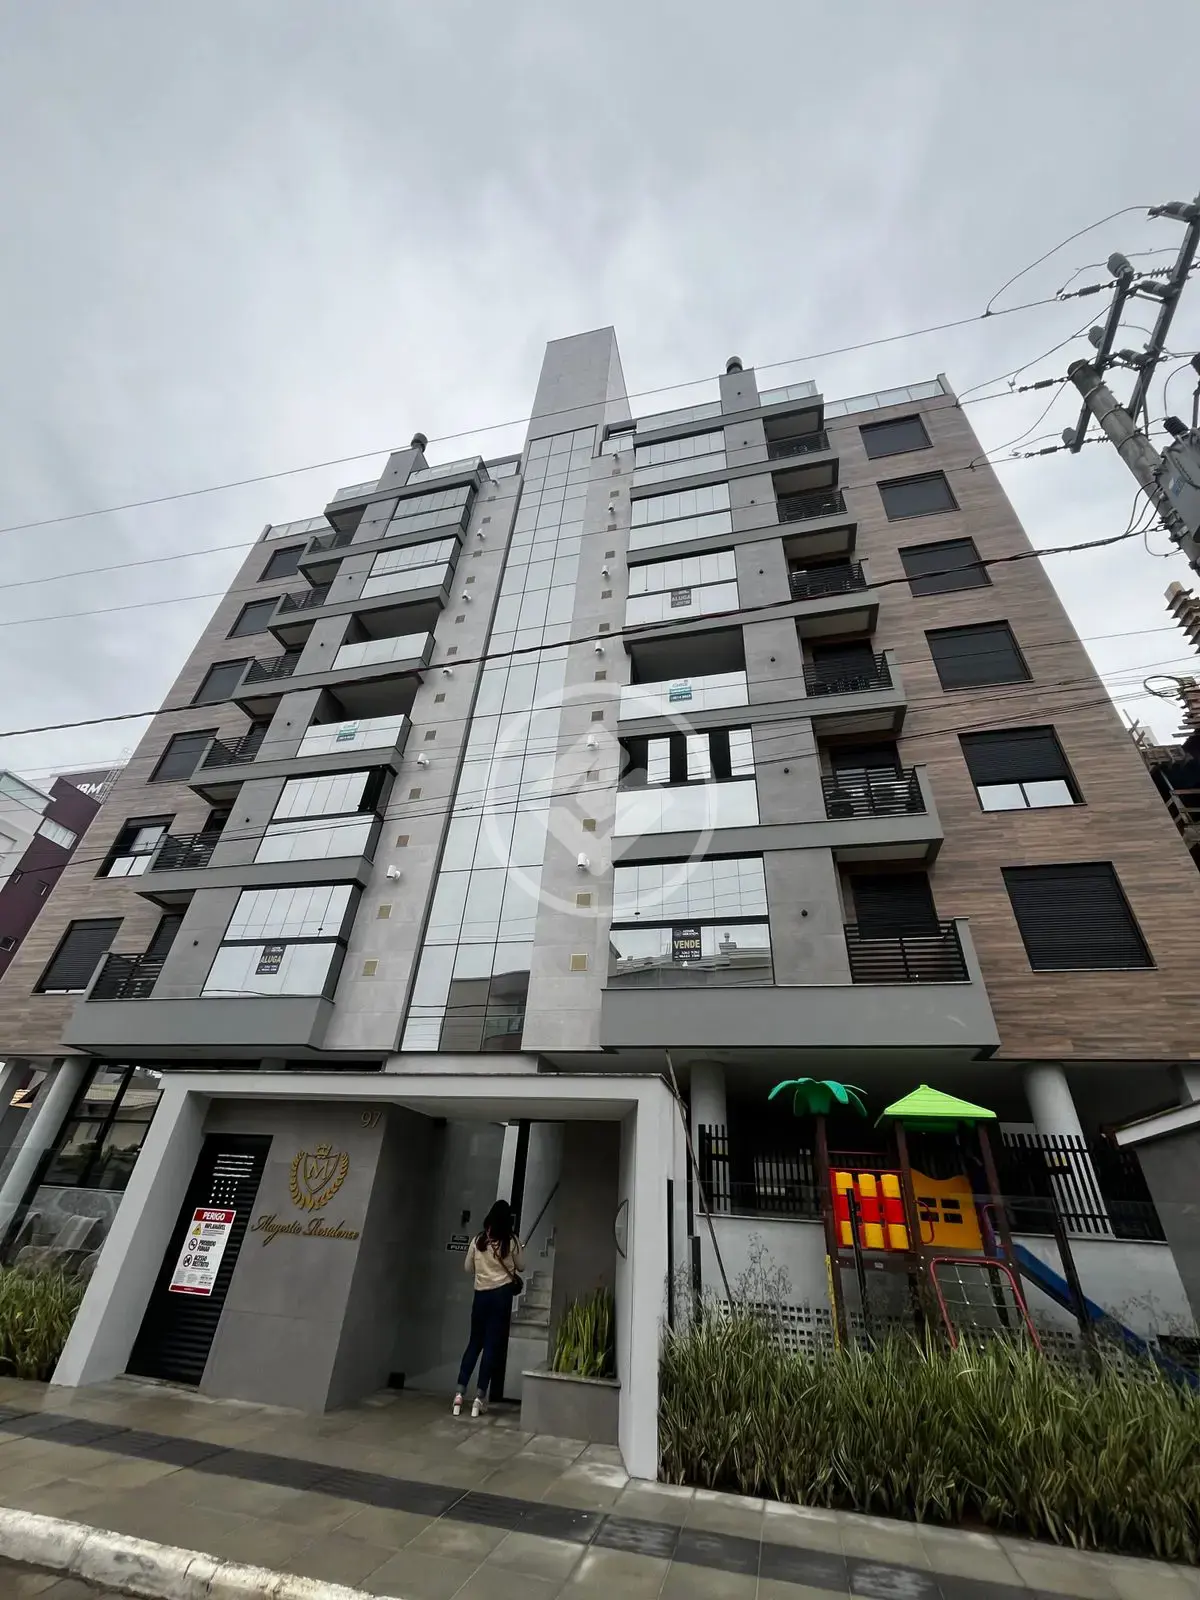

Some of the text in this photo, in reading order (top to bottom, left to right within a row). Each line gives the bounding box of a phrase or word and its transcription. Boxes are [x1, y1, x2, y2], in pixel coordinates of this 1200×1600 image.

[673, 939, 700, 949] VENDE
[260, 955, 281, 964] ALUGA
[361, 1111, 383, 1128] 97
[305, 1160, 331, 1180] M
[202, 1211, 226, 1221] PERIGO
[302, 1218, 360, 1240] Residence
